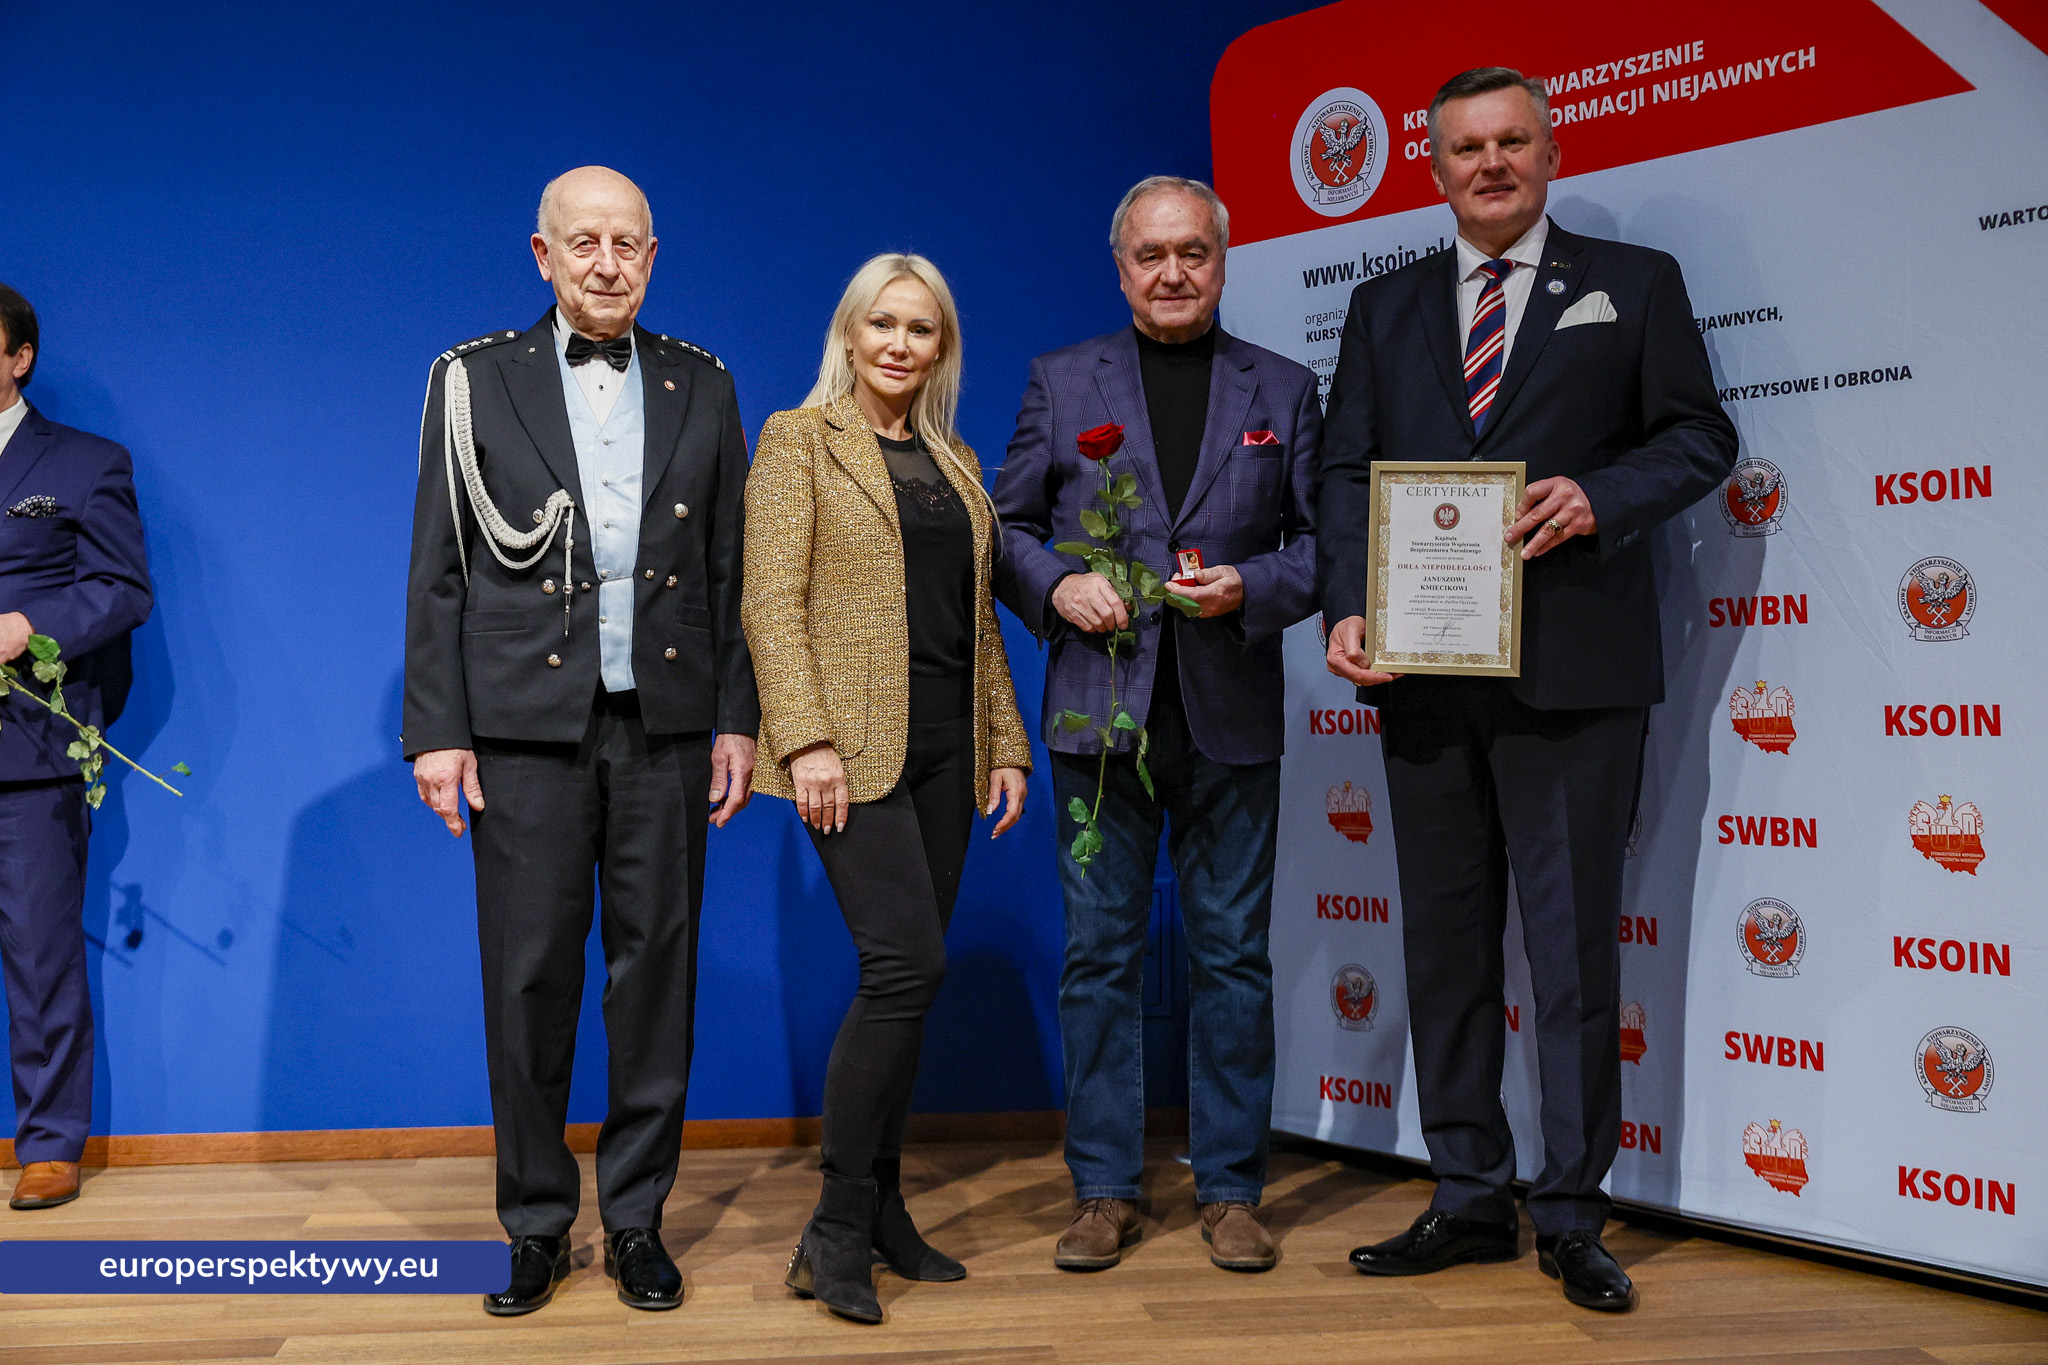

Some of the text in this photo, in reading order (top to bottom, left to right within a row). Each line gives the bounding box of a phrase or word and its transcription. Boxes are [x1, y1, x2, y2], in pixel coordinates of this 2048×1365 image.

[1544, 40, 1704, 97] WARZYSZENIE
[1550, 46, 1816, 128] ORMACJI NIEJAWNYCH
[1311, 104, 1362, 130] STOWARZYSZENIE
[1366, 128, 1374, 168] OCHRONY
[1326, 190, 1359, 202] NIEJAWNYCH
[1327, 184, 1358, 196] INFORMACJI
[1978, 205, 2048, 231] WARTO
[1306, 326, 1343, 343] KURSY
[1694, 306, 1783, 334] EJAWNYCH,
[1718, 365, 1912, 403] KRYZYSOWE I OBRONA
[1406, 486, 1489, 497] CERTYFIKAT
[1876, 465, 1992, 507] KSOIN
[1422, 563, 1492, 571] NIEPODLEGŁOŚCI
[1909, 559, 1963, 577] STOWARZYSZENIE
[1709, 594, 1809, 629] SWBN
[1900, 587, 1911, 620] KRAJOWE
[1965, 583, 1974, 617] OCHRONY
[1309, 709, 1381, 735] KSOIN
[1885, 705, 2002, 738] KSOIN
[1718, 816, 1818, 850] SWBN
[1317, 894, 1389, 924] KSOIN
[1618, 915, 1658, 946] BN
[1894, 936, 2011, 978] KSOIN
[1725, 1031, 1825, 1073] SWBN
[1926, 1028, 1981, 1048] STOWARZYSZENIE
[1981, 1058, 1992, 1092] OCHRONY
[1320, 1075, 1393, 1110] KSOIN
[1620, 1121, 1662, 1154] BN
[1899, 1166, 2016, 1217] KSOIN
